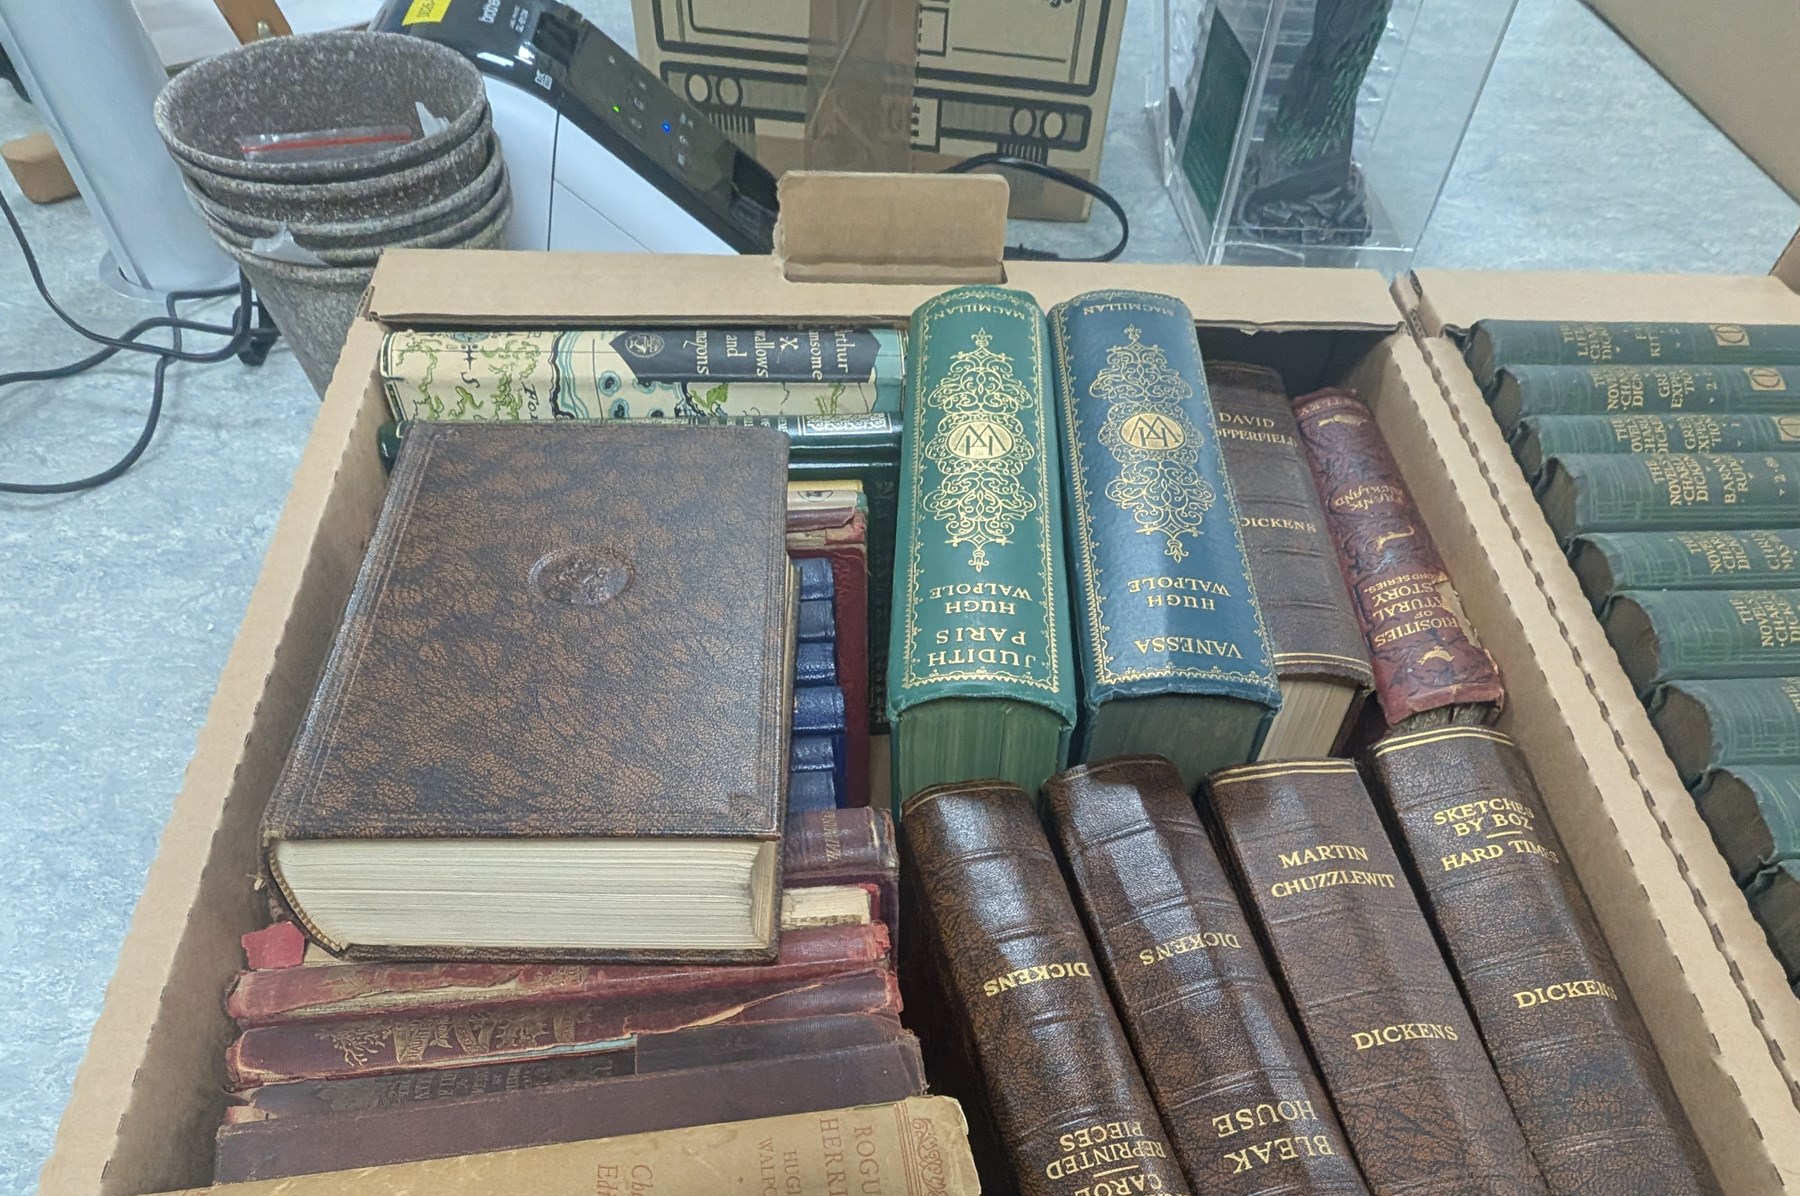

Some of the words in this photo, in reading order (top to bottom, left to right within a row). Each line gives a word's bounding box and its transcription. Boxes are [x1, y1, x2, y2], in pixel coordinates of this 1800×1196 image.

[933, 304, 1025, 320] MACMILLAN
[1083, 302, 1176, 316] MACMILLAN
[725, 334, 747, 358] and
[834, 328, 855, 373] rthur
[1219, 412, 1275, 428] DAVID
[929, 582, 1033, 602] WALPOLE
[1127, 576, 1232, 598] WALPOLE
[1371, 582, 1434, 608] STORY.
[945, 600, 1016, 615] HUGH
[1147, 594, 1215, 611] HUGH
[1373, 596, 1443, 621] ATURAL
[1414, 609, 1434, 619] OF
[936, 626, 1026, 646] PARIS
[1375, 617, 1459, 648] RIOSITIES
[928, 648, 1036, 668] JUDITH
[1133, 636, 1244, 659] VANESSA
[1433, 798, 1535, 826] SKETCHES
[1452, 817, 1484, 837] BY
[1491, 813, 1534, 831] BOZ
[1278, 844, 1369, 869] MARTIN
[1441, 844, 1504, 871] HARD
[1508, 839, 1559, 864] TIMES
[1270, 870, 1396, 898] CHUZZLEWIT
[1139, 932, 1242, 966] DICKENS
[983, 961, 1091, 998] DICKENS
[1513, 979, 1619, 1009] DICKENS
[1351, 1023, 1459, 1050] DICKENS
[1212, 1100, 1318, 1138] HOUSE
[1059, 1121, 1145, 1152] PIECES
[1046, 1140, 1167, 1180] REPRINTED
[1223, 1135, 1335, 1175] BLEAK
